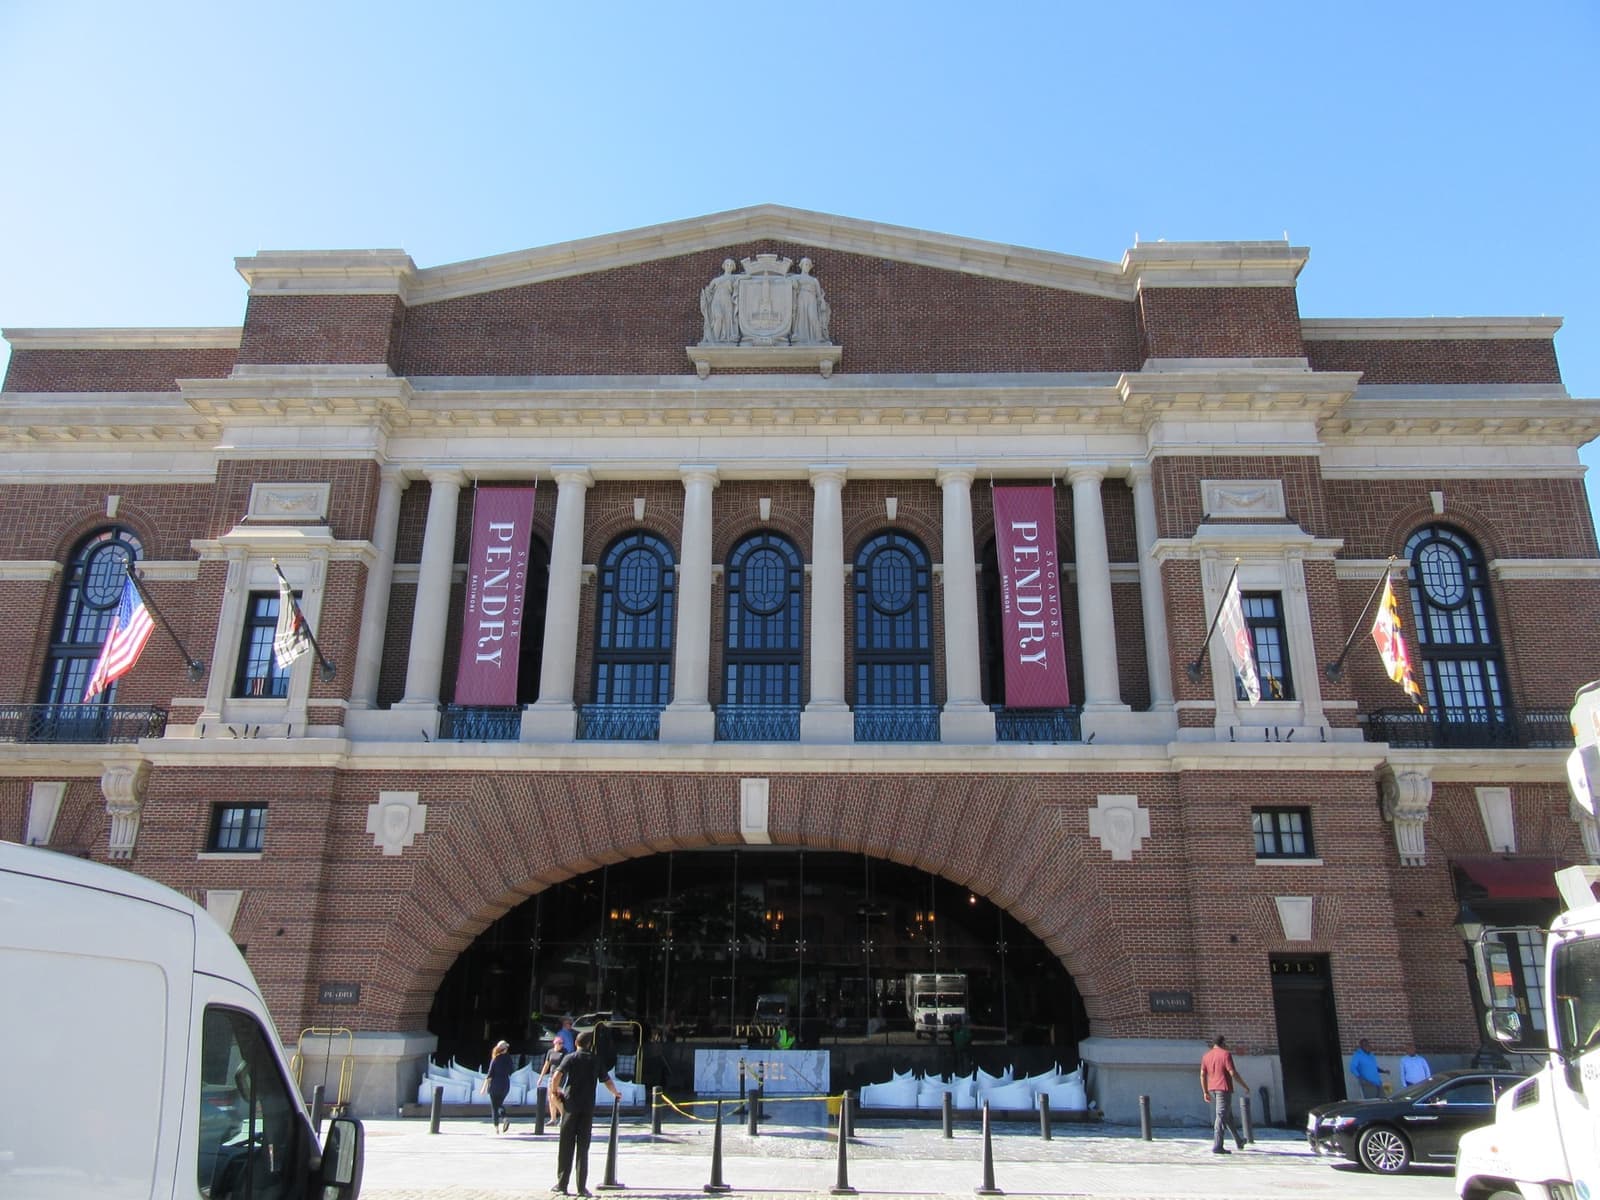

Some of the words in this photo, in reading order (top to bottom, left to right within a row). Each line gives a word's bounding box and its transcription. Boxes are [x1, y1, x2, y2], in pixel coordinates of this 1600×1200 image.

[469, 574, 479, 613] BALTIMORE
[475, 520, 515, 669] PENDRY
[511, 551, 526, 637] SAGAMORE
[1011, 520, 1048, 669] PENDRY
[1046, 550, 1060, 638] SAGAMORE
[735, 1024, 781, 1037] PEND
